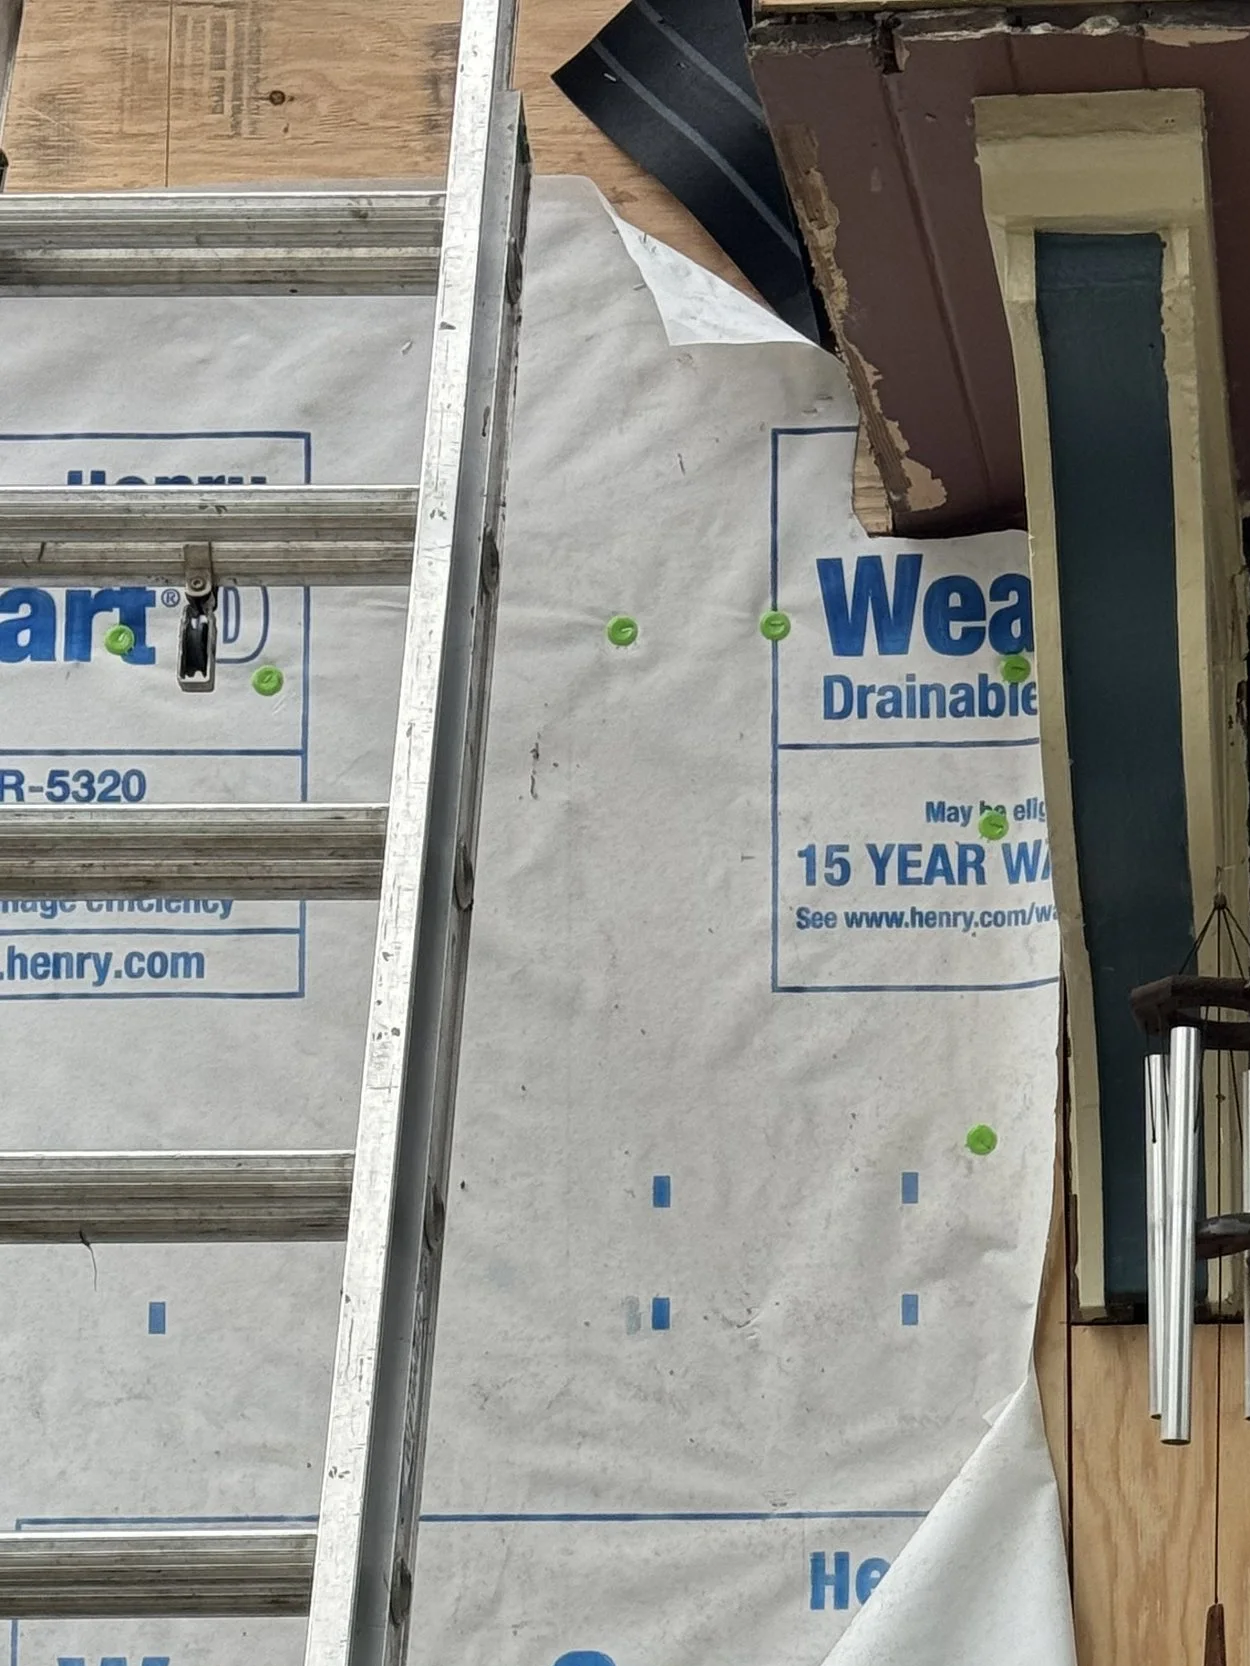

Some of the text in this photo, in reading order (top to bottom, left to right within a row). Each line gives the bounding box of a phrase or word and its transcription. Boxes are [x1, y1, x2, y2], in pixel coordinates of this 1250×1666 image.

[926, 800, 973, 827] May
[798, 844, 851, 886] 15
[867, 843, 986, 887] YEAR
[795, 906, 837, 929] See
